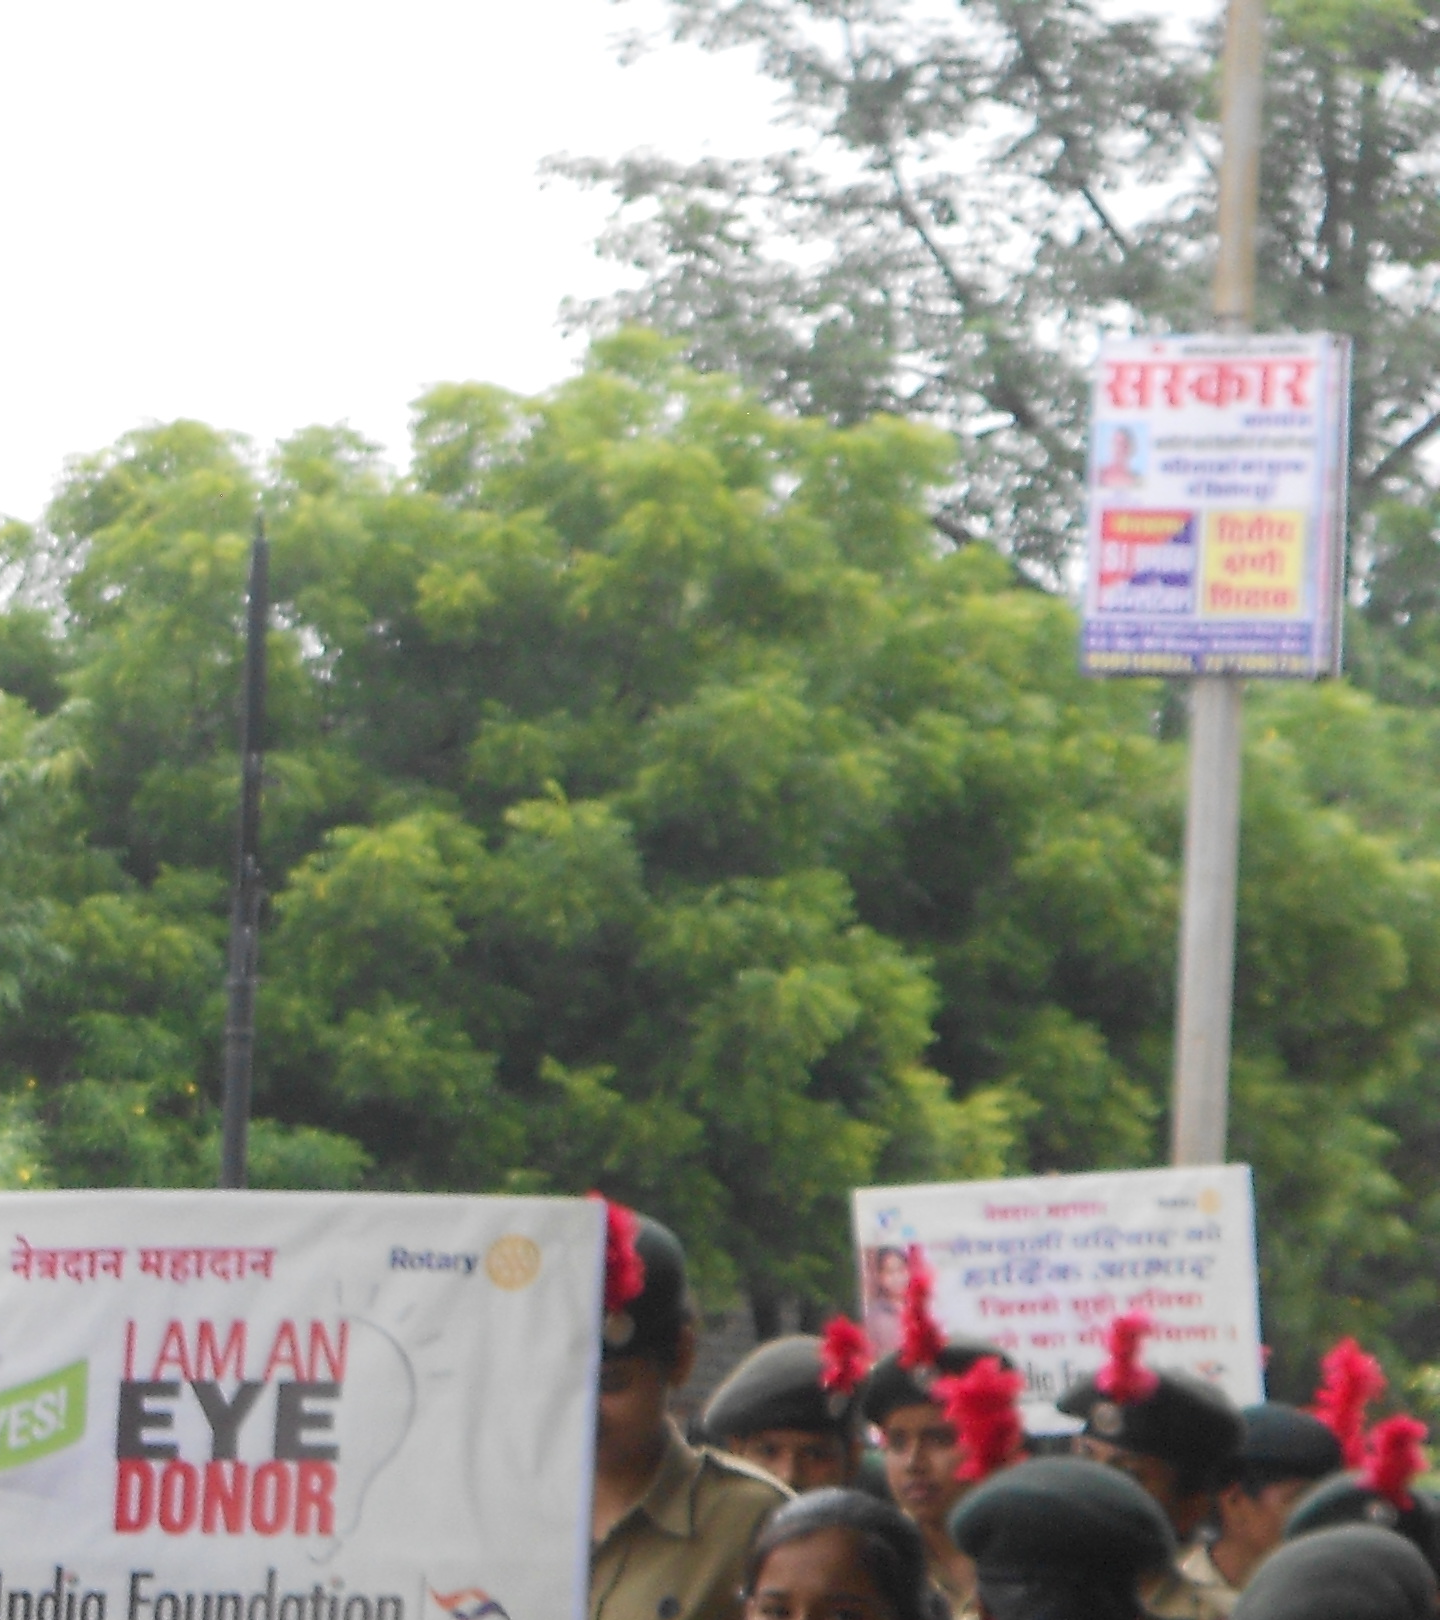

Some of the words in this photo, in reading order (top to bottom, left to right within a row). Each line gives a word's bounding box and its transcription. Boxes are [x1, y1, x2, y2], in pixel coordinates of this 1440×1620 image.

[11, 1233, 126, 1284] नेत्रदान
[140, 1247, 278, 1284] महादान
[389, 1246, 479, 1275] Rotary
[122, 1318, 138, 1382] I
[151, 1318, 248, 1383] AM
[262, 1318, 350, 1384] AN
[115, 1378, 342, 1461] EYE
[113, 1459, 337, 1537] DONOR
